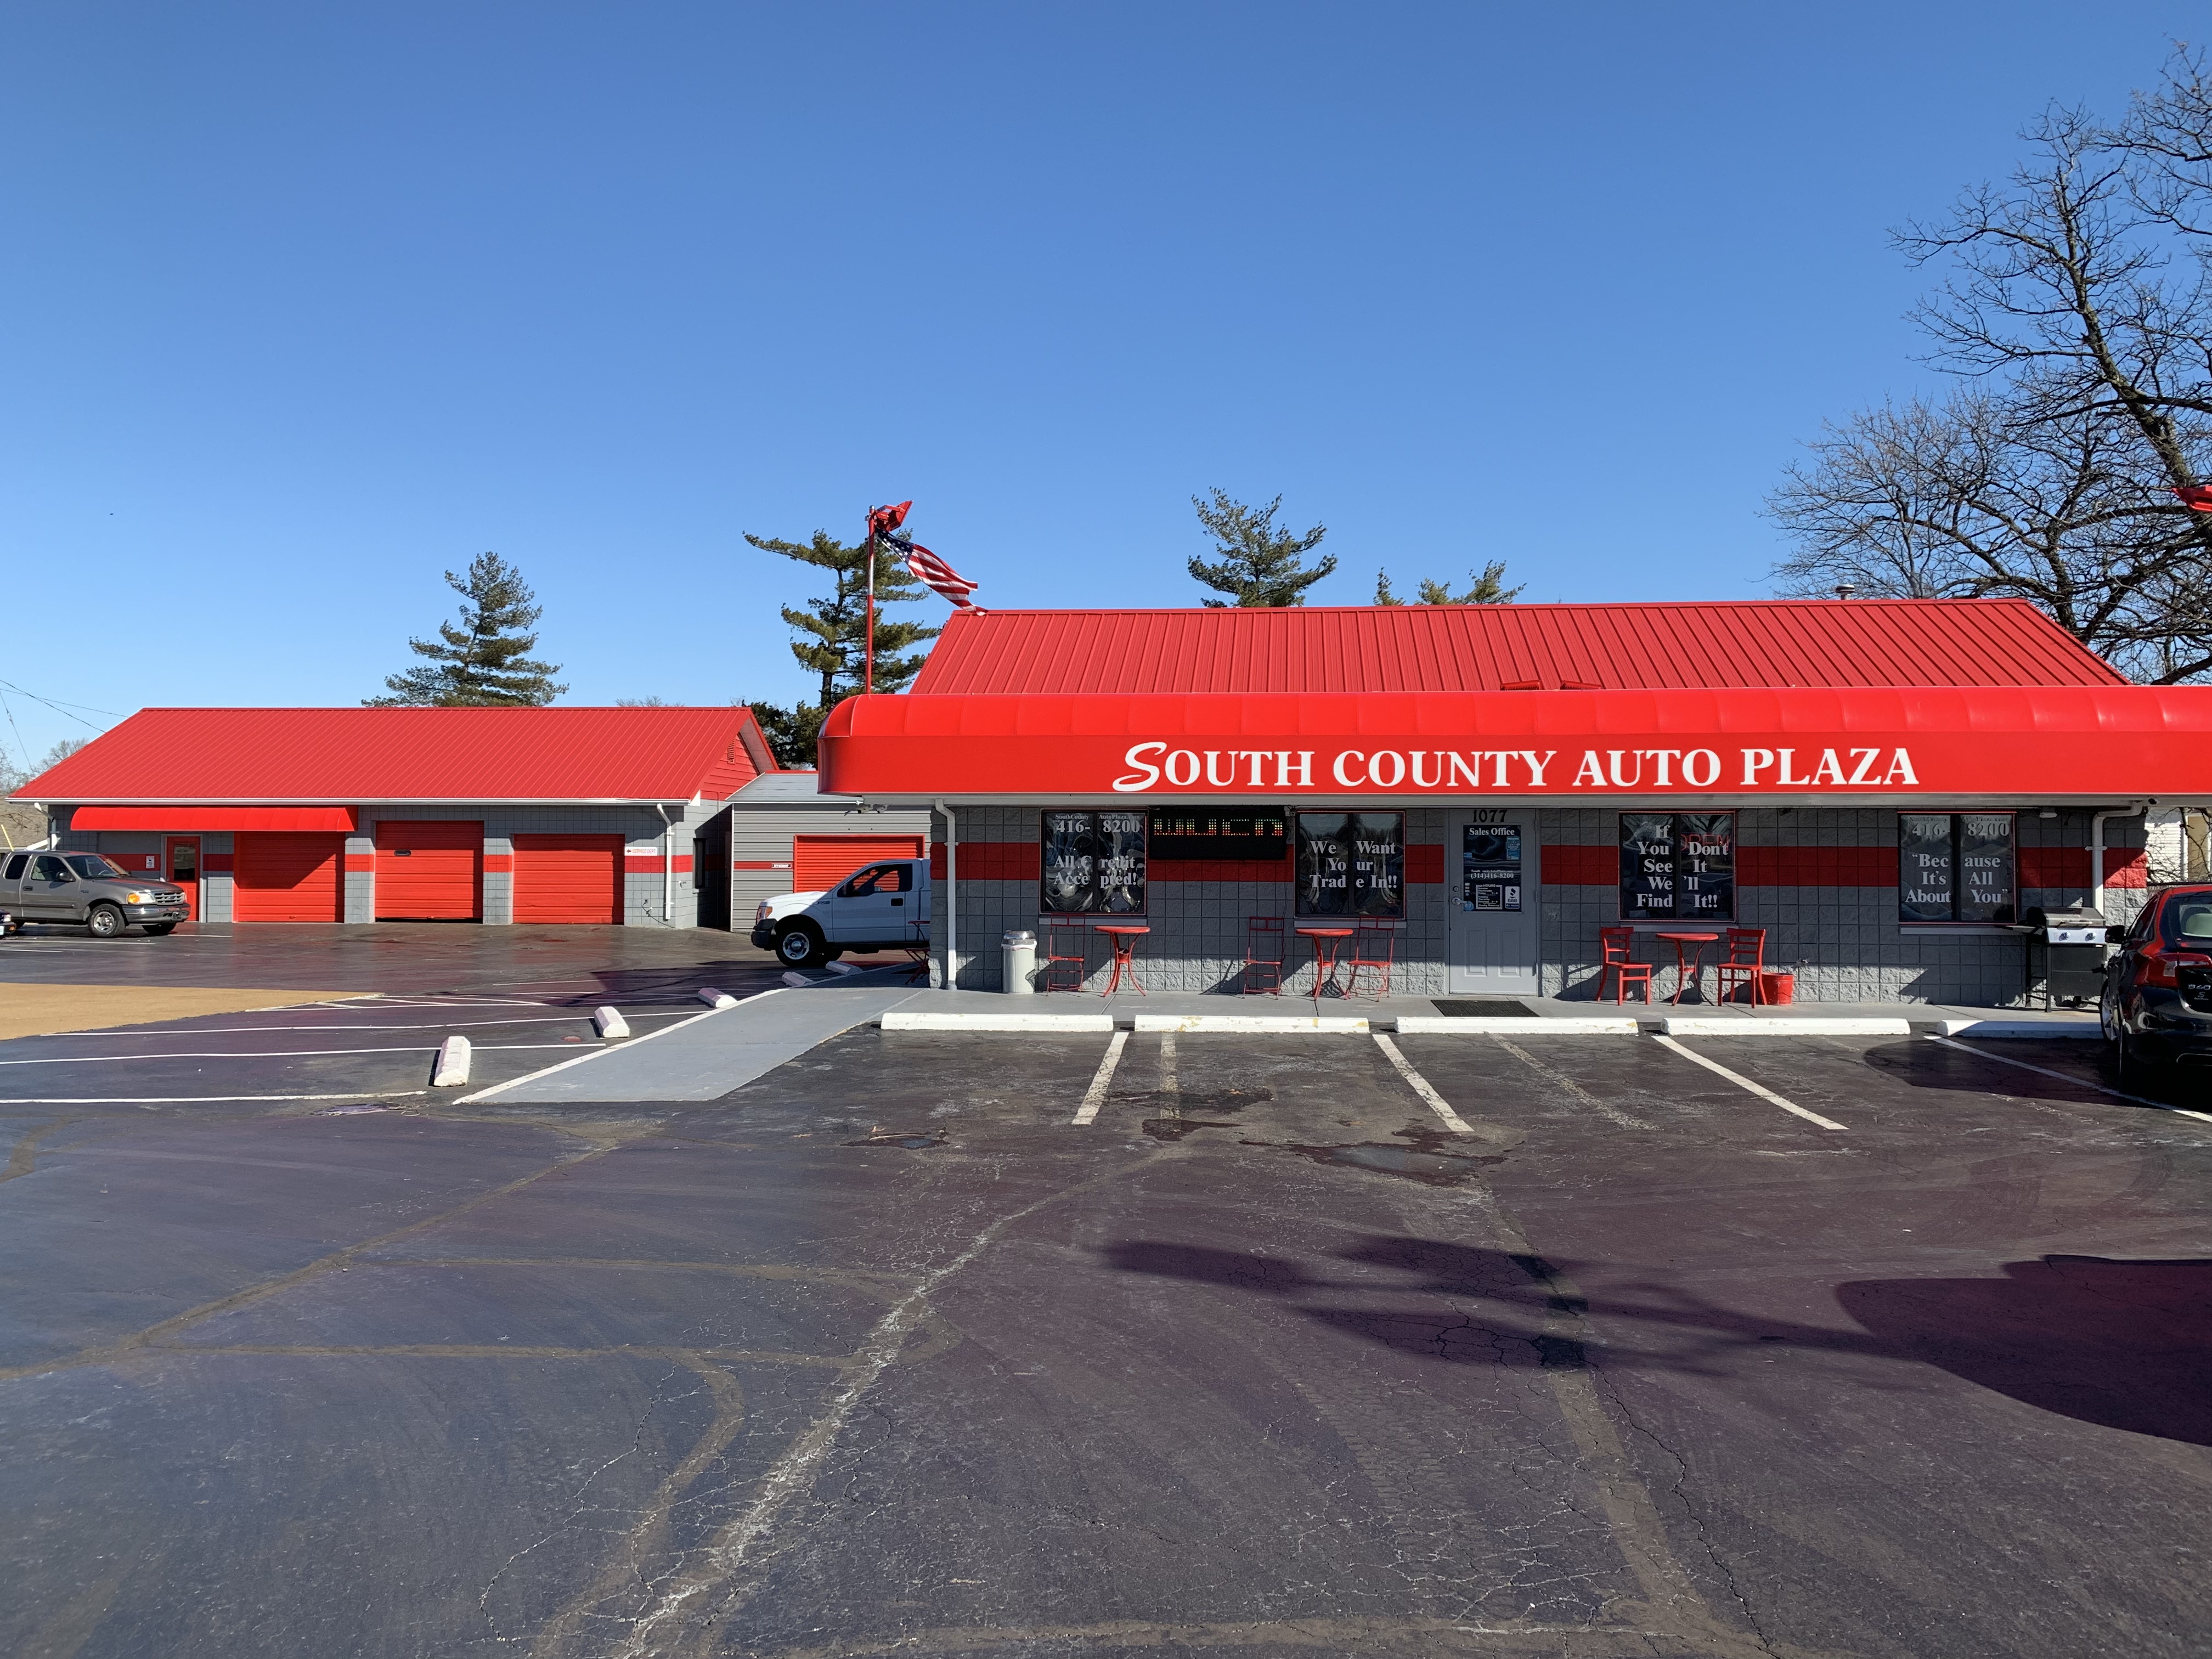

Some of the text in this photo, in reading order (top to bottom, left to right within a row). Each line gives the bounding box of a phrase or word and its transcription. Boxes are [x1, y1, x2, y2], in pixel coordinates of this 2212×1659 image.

[1113, 742, 1920, 791] SOUTH COUNTY AUTO PLAZA
[1473, 809, 1508, 822] 1077
[1056, 820, 1091, 833] 416-
[1103, 820, 1141, 833] 8200
[1656, 825, 1671, 838] If
[1967, 822, 2010, 836] 8200
[1310, 840, 1396, 854] We Want
[1637, 841, 1728, 855] You Don't
[1054, 855, 1074, 868] All
[1644, 859, 1707, 873] See It
[1922, 871, 1993, 885] It's All
[1636, 893, 1718, 908] Find It!!
[1905, 889, 1951, 903] About
